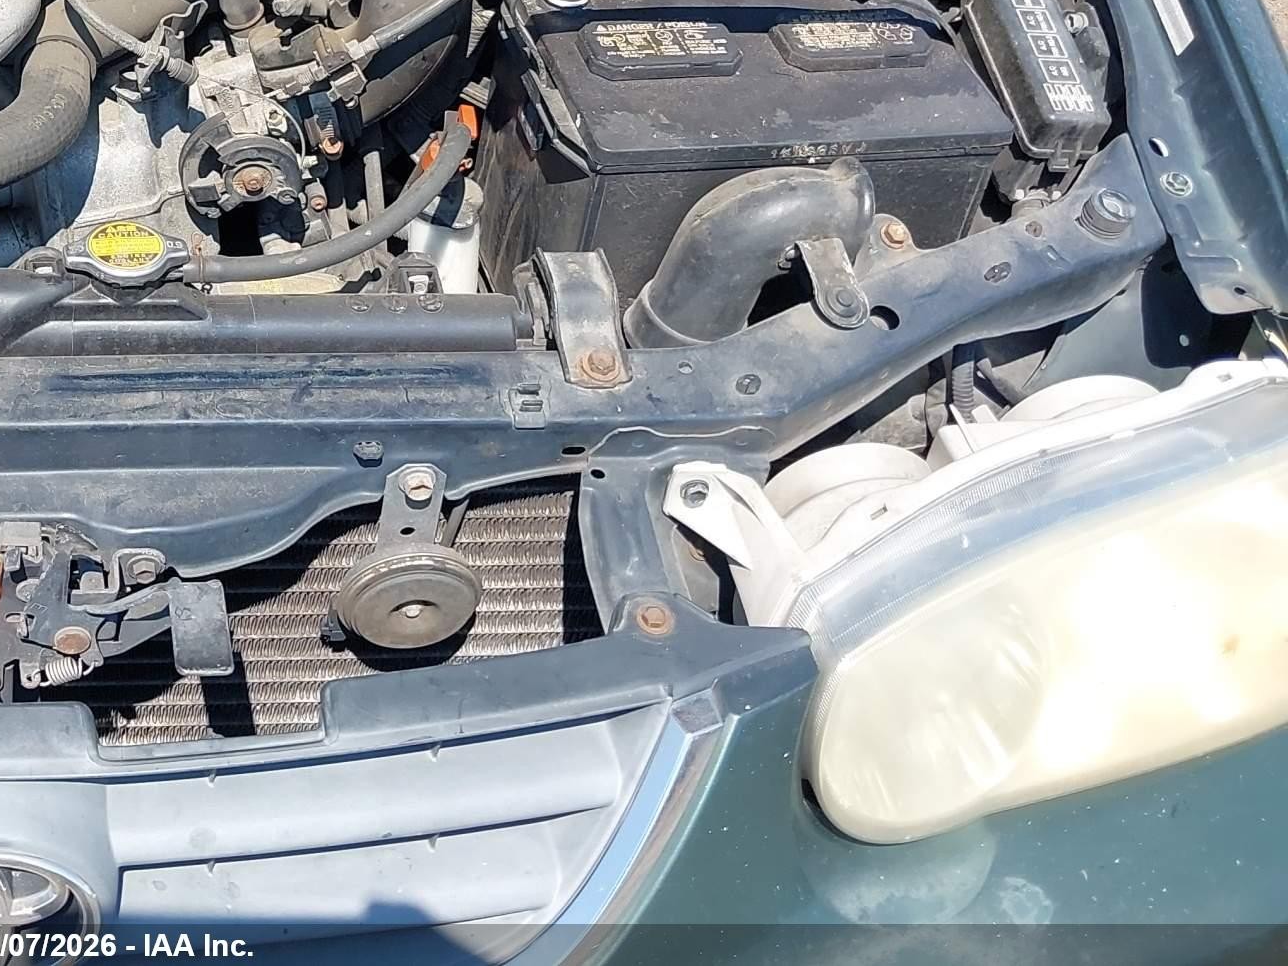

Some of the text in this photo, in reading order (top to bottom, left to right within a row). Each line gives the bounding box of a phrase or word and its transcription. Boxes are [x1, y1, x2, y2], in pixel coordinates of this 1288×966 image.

[607, 23, 653, 31] DANGER
[98, 230, 150, 239] CAUTION
[166, 240, 183, 249] 0.9
